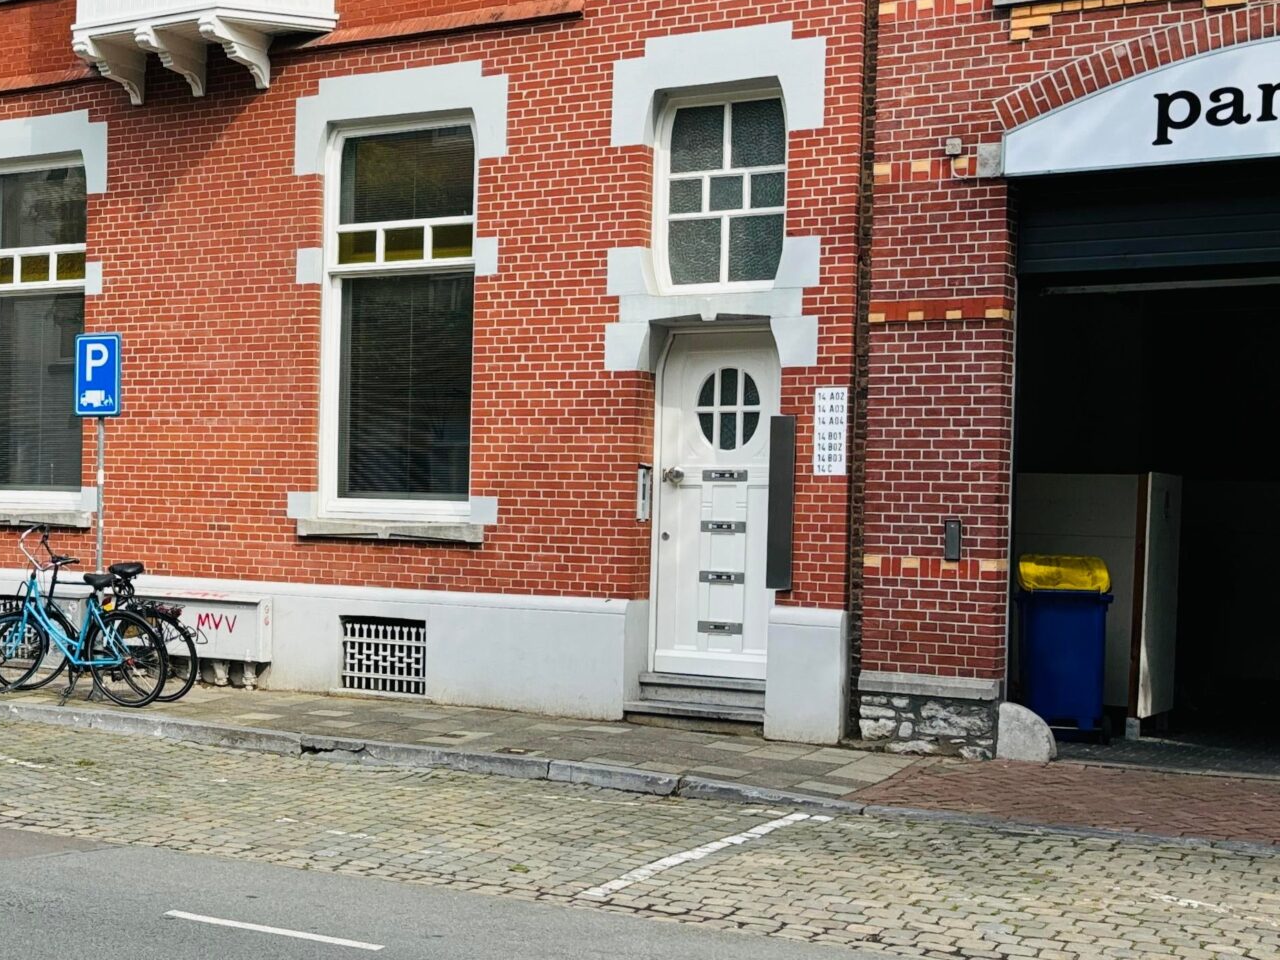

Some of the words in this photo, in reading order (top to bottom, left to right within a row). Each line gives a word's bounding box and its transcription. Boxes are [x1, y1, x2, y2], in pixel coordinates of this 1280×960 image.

[86, 343, 109, 382] P
[817, 392, 826, 401] 14
[829, 391, 845, 401] A02
[817, 404, 826, 413] 14
[829, 404, 845, 413] A03
[817, 417, 826, 425] 14
[828, 416, 844, 425] A04
[817, 432, 826, 441] 14
[827, 431, 842, 441] B01
[817, 443, 826, 451] 14
[827, 442, 843, 451] B02
[817, 453, 826, 462] 14
[827, 453, 843, 462] B03
[817, 464, 826, 473] 14
[827, 464, 833, 473] C
[196, 612, 237, 634] MVV
